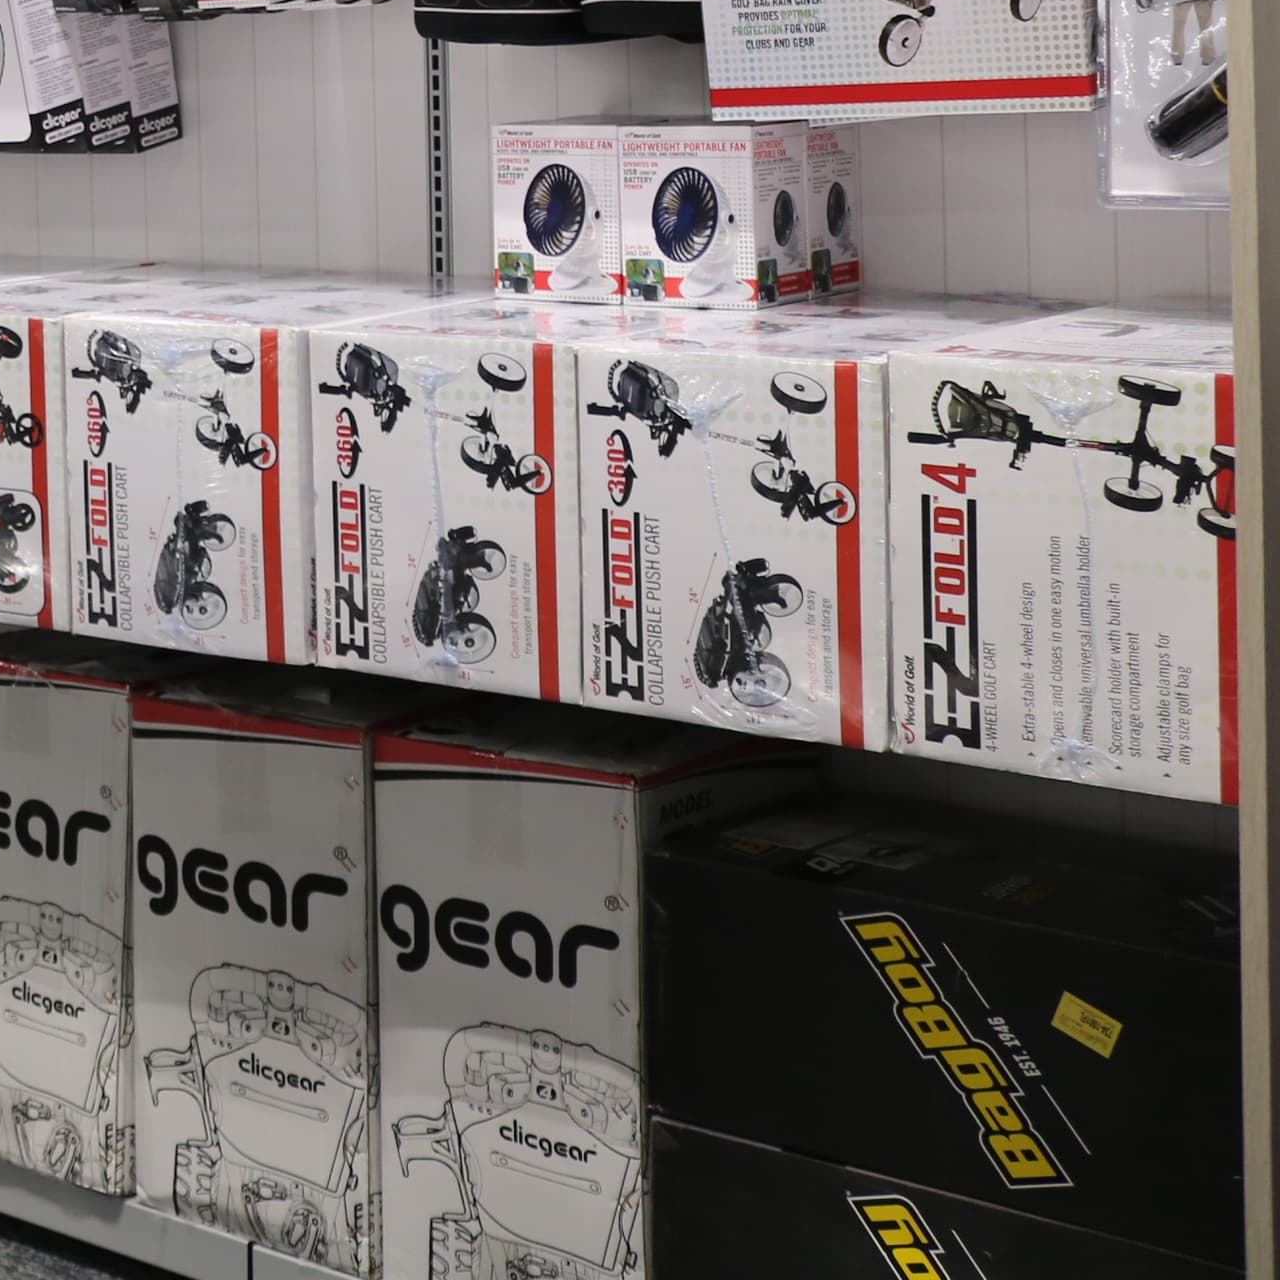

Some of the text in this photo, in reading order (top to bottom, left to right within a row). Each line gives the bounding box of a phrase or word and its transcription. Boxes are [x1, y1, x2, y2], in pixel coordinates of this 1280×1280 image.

[738, 11, 779, 22] PROVIDES
[784, 22, 827, 34] FOR YOUR
[745, 37, 815, 50] CLUBS AND GEAR
[42, 106, 82, 131] clicgear
[90, 110, 128, 133] clicgear
[496, 139, 613, 150] LIGHTWEIGHT PORTABLE FAN
[622, 141, 747, 152] LIGHTWEIGHT PORTABLE FAN
[921, 463, 977, 495] 4
[115, 465, 133, 631] COLLAPSIBLE PUSH CART
[1048, 535, 1061, 577] motion
[1076, 535, 1090, 573] holder
[368, 487, 388, 664] COLLAPSIBLE PUSH CART
[1051, 579, 1064, 608] easy
[644, 515, 664, 706] COLLAPSIBLE PUSH CART
[807, 590, 817, 610] easy
[1051, 610, 1063, 630] one
[1077, 574, 1092, 628] umbrella
[593, 623, 601, 680] World of Golf
[823, 634, 832, 655] and
[1050, 631, 1062, 643] in
[1077, 629, 1093, 685] universal
[1020, 582, 1036, 743] Extra-stable 4-wheel design
[1049, 645, 1064, 682] closes
[1106, 583, 1123, 755] Scorecard holder with built-in
[904, 656, 916, 726] World of Golf
[983, 641, 998, 752] 4-WHEEL GOLF CART
[1050, 684, 1064, 708] and
[1126, 632, 1144, 758] storage compartment
[1156, 633, 1174, 763] Adjustable clamps for
[1177, 665, 1193, 765] any size golf bag
[659, 787, 714, 824] MODEL
[137, 834, 349, 932] gear
[380, 883, 621, 989] gear
[12, 981, 85, 1020] clicgear
[855, 921, 1057, 1179] BagBoy
[988, 1016, 1042, 1077] EST. 1946
[238, 1053, 326, 1094] clicgear
[499, 1120, 597, 1164] clicgear
